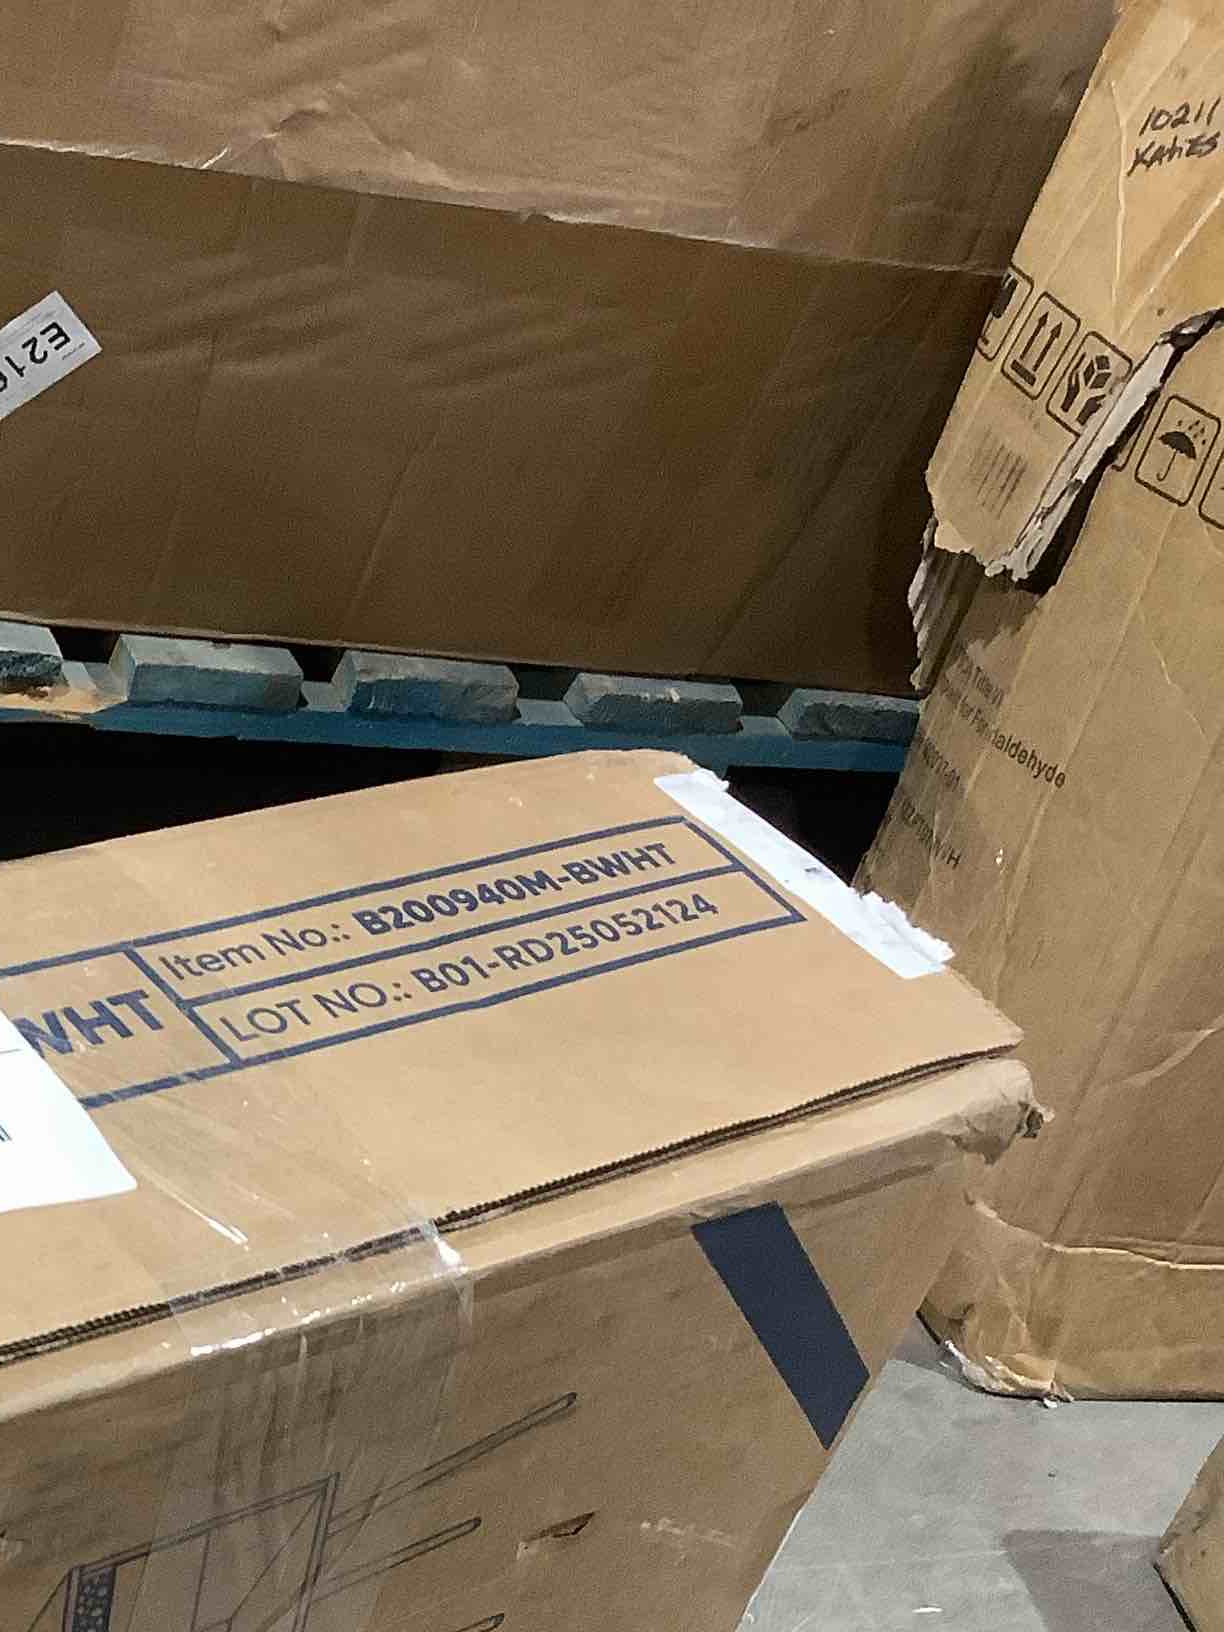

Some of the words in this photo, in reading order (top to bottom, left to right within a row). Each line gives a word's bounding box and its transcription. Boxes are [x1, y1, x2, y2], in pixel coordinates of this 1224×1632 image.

[1138, 96, 1221, 137] 10211
[163, 938, 266, 982] Item
[352, 841, 679, 938] B200940M-BWHT
[218, 998, 304, 1045] LOT
[414, 890, 720, 995] B01-RD25052124
